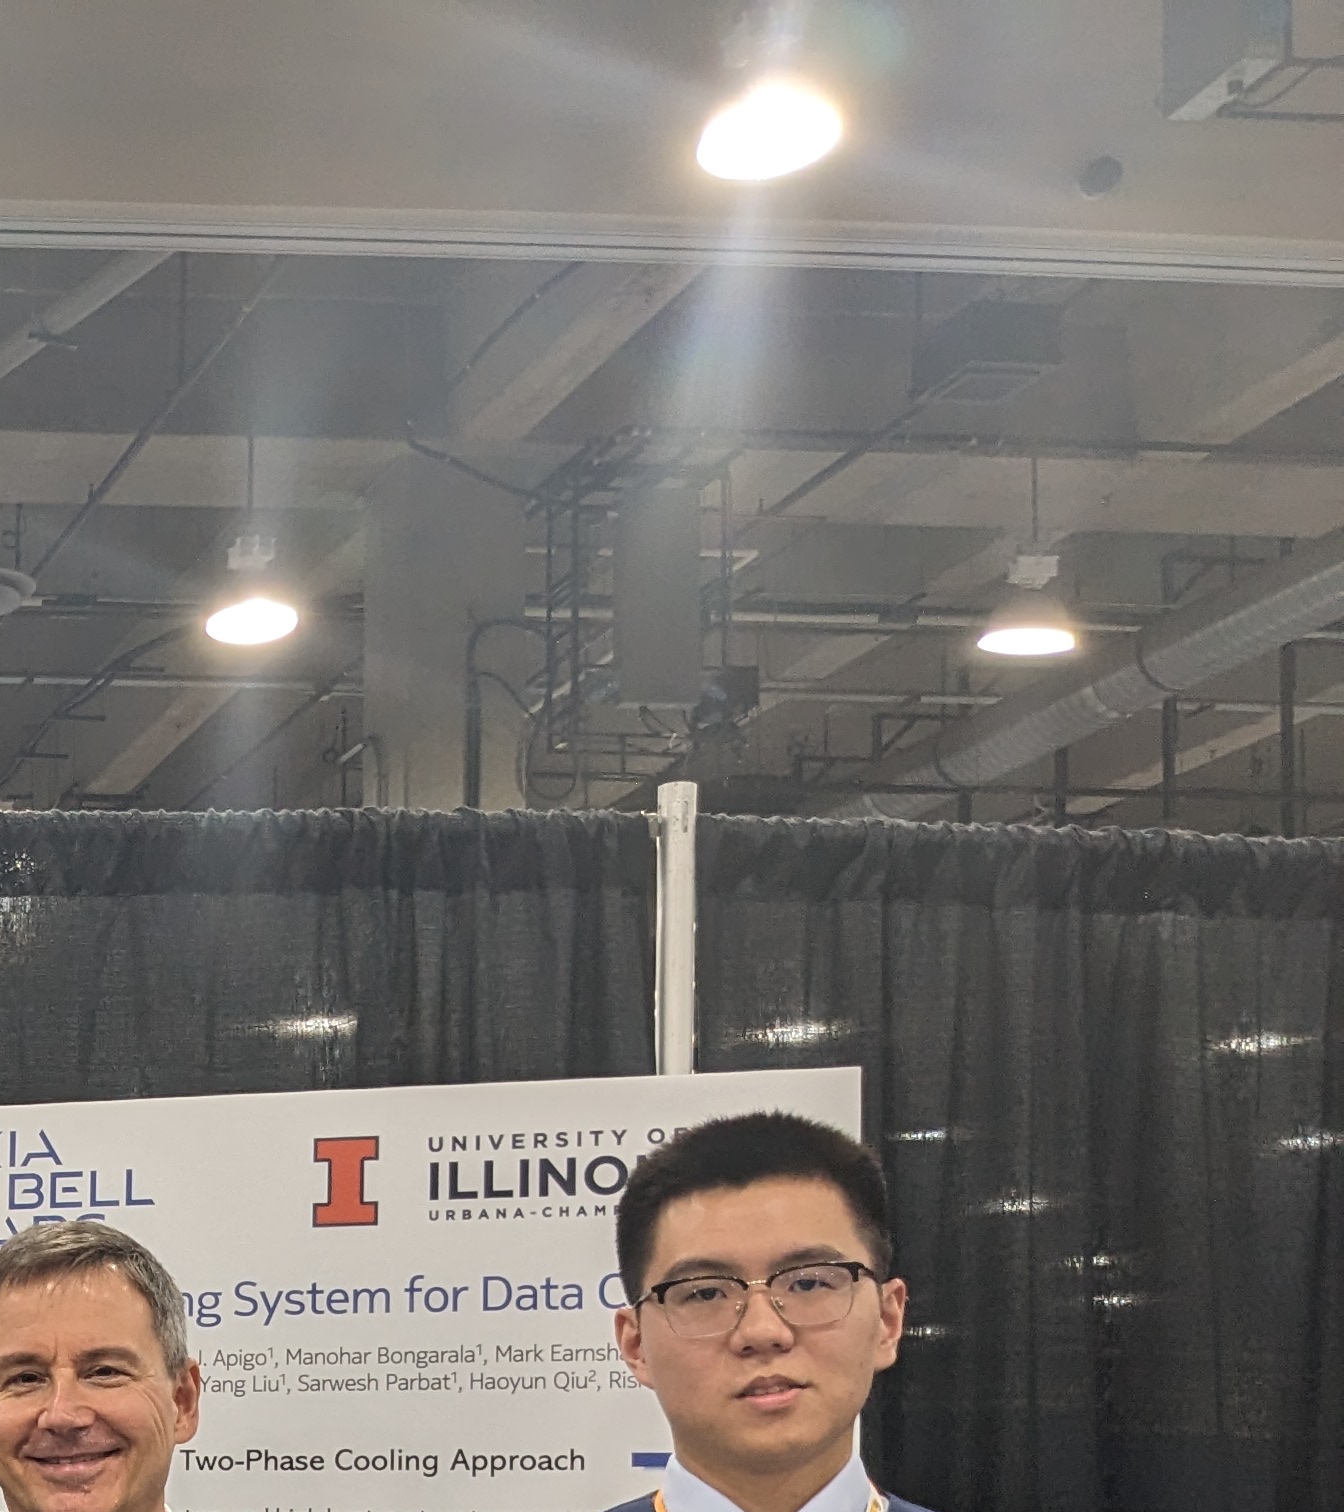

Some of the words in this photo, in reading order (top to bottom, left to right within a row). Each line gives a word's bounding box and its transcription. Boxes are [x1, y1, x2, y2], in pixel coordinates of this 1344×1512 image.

[427, 1129, 628, 1152] UNIVERSITY
[8, 1169, 155, 1210] BELL
[428, 1154, 647, 1201] ILLINO
[233, 1280, 391, 1327] System
[404, 1275, 469, 1314] for
[482, 1276, 584, 1312] Data
[286, 1346, 372, 1366] Manohar
[495, 1343, 545, 1363] Mark
[550, 1342, 625, 1362] Earnsh
[199, 1376, 247, 1398] Yang
[297, 1372, 379, 1393] Sarwesh
[469, 1372, 547, 1395] Haoyun
[609, 1370, 643, 1389] Ris
[179, 1448, 325, 1472] Two-Phase
[334, 1448, 440, 1478] Cooling
[450, 1448, 586, 1478] Approach
